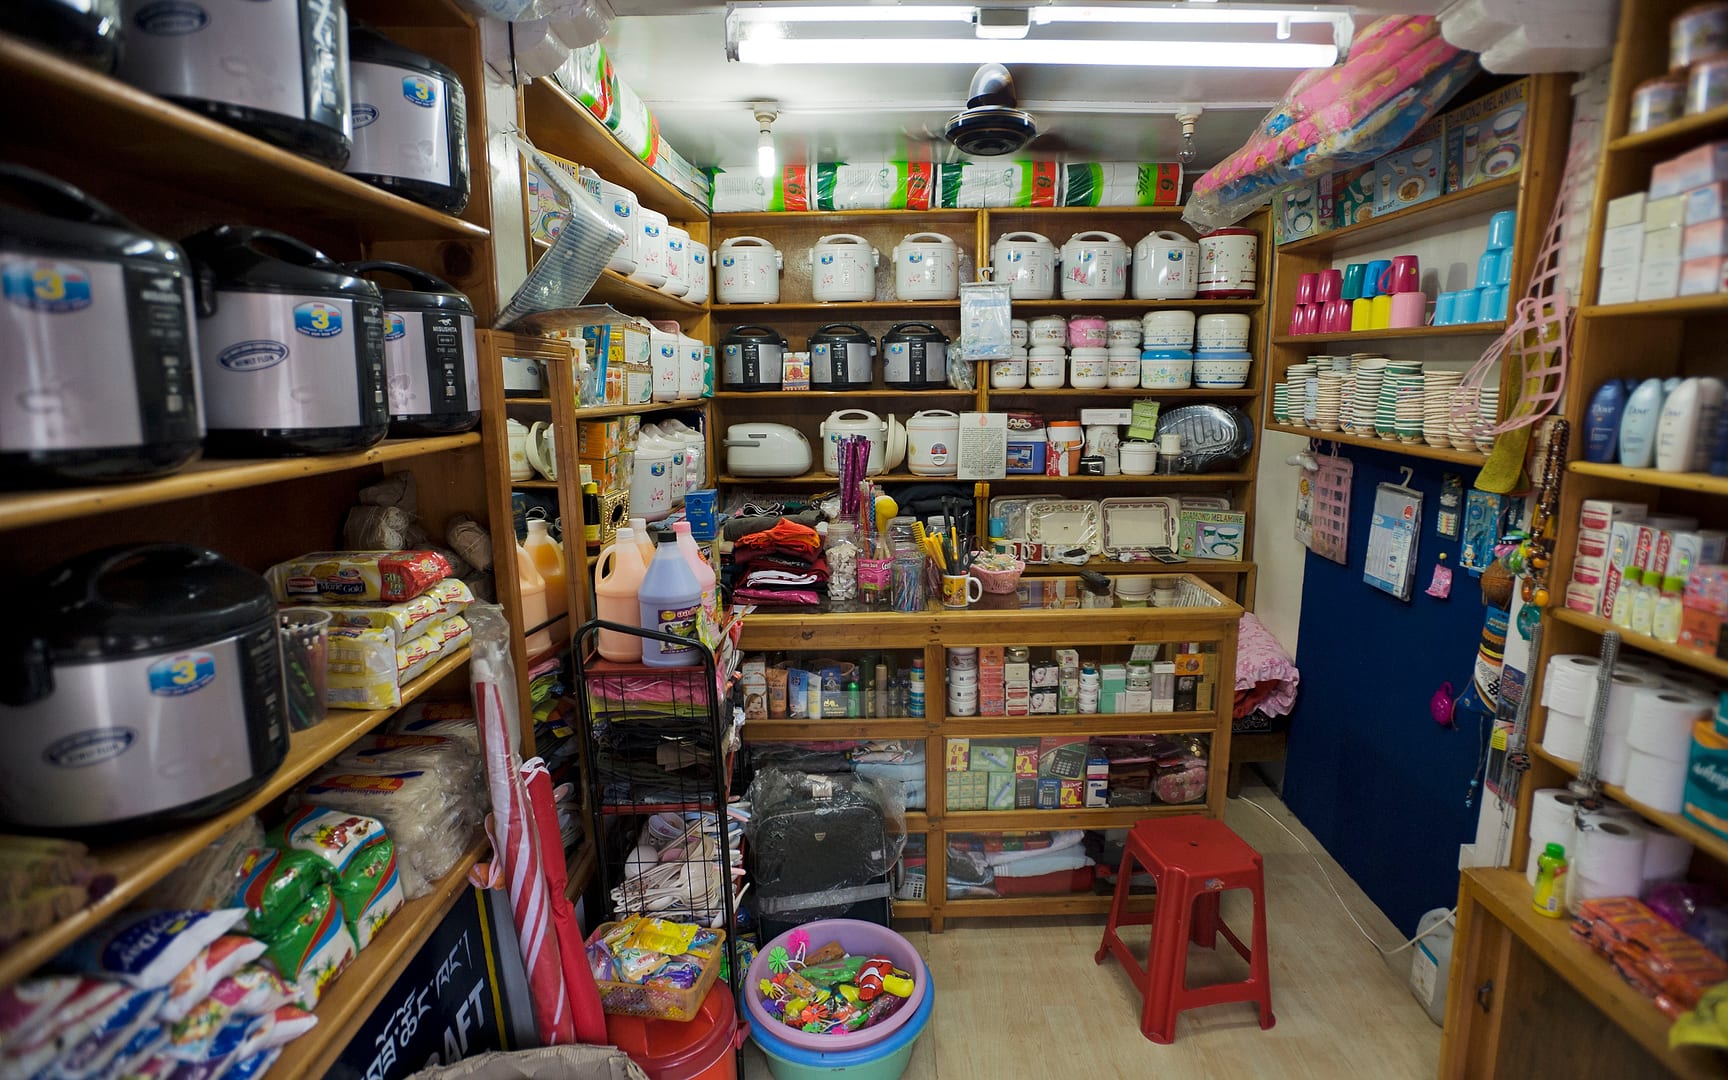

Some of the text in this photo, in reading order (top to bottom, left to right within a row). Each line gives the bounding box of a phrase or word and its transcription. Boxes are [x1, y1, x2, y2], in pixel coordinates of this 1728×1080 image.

[415, 82, 430, 100] 3
[787, 183, 803, 195] 6
[1160, 178, 1175, 192] 6
[33, 269, 66, 300] 3
[311, 308, 330, 330] 3
[1637, 530, 1653, 571] Colga
[1657, 534, 1672, 575] Colga
[343, 584, 363, 594] Gold
[1603, 569, 1619, 618] Colgate
[172, 660, 198, 685] 3
